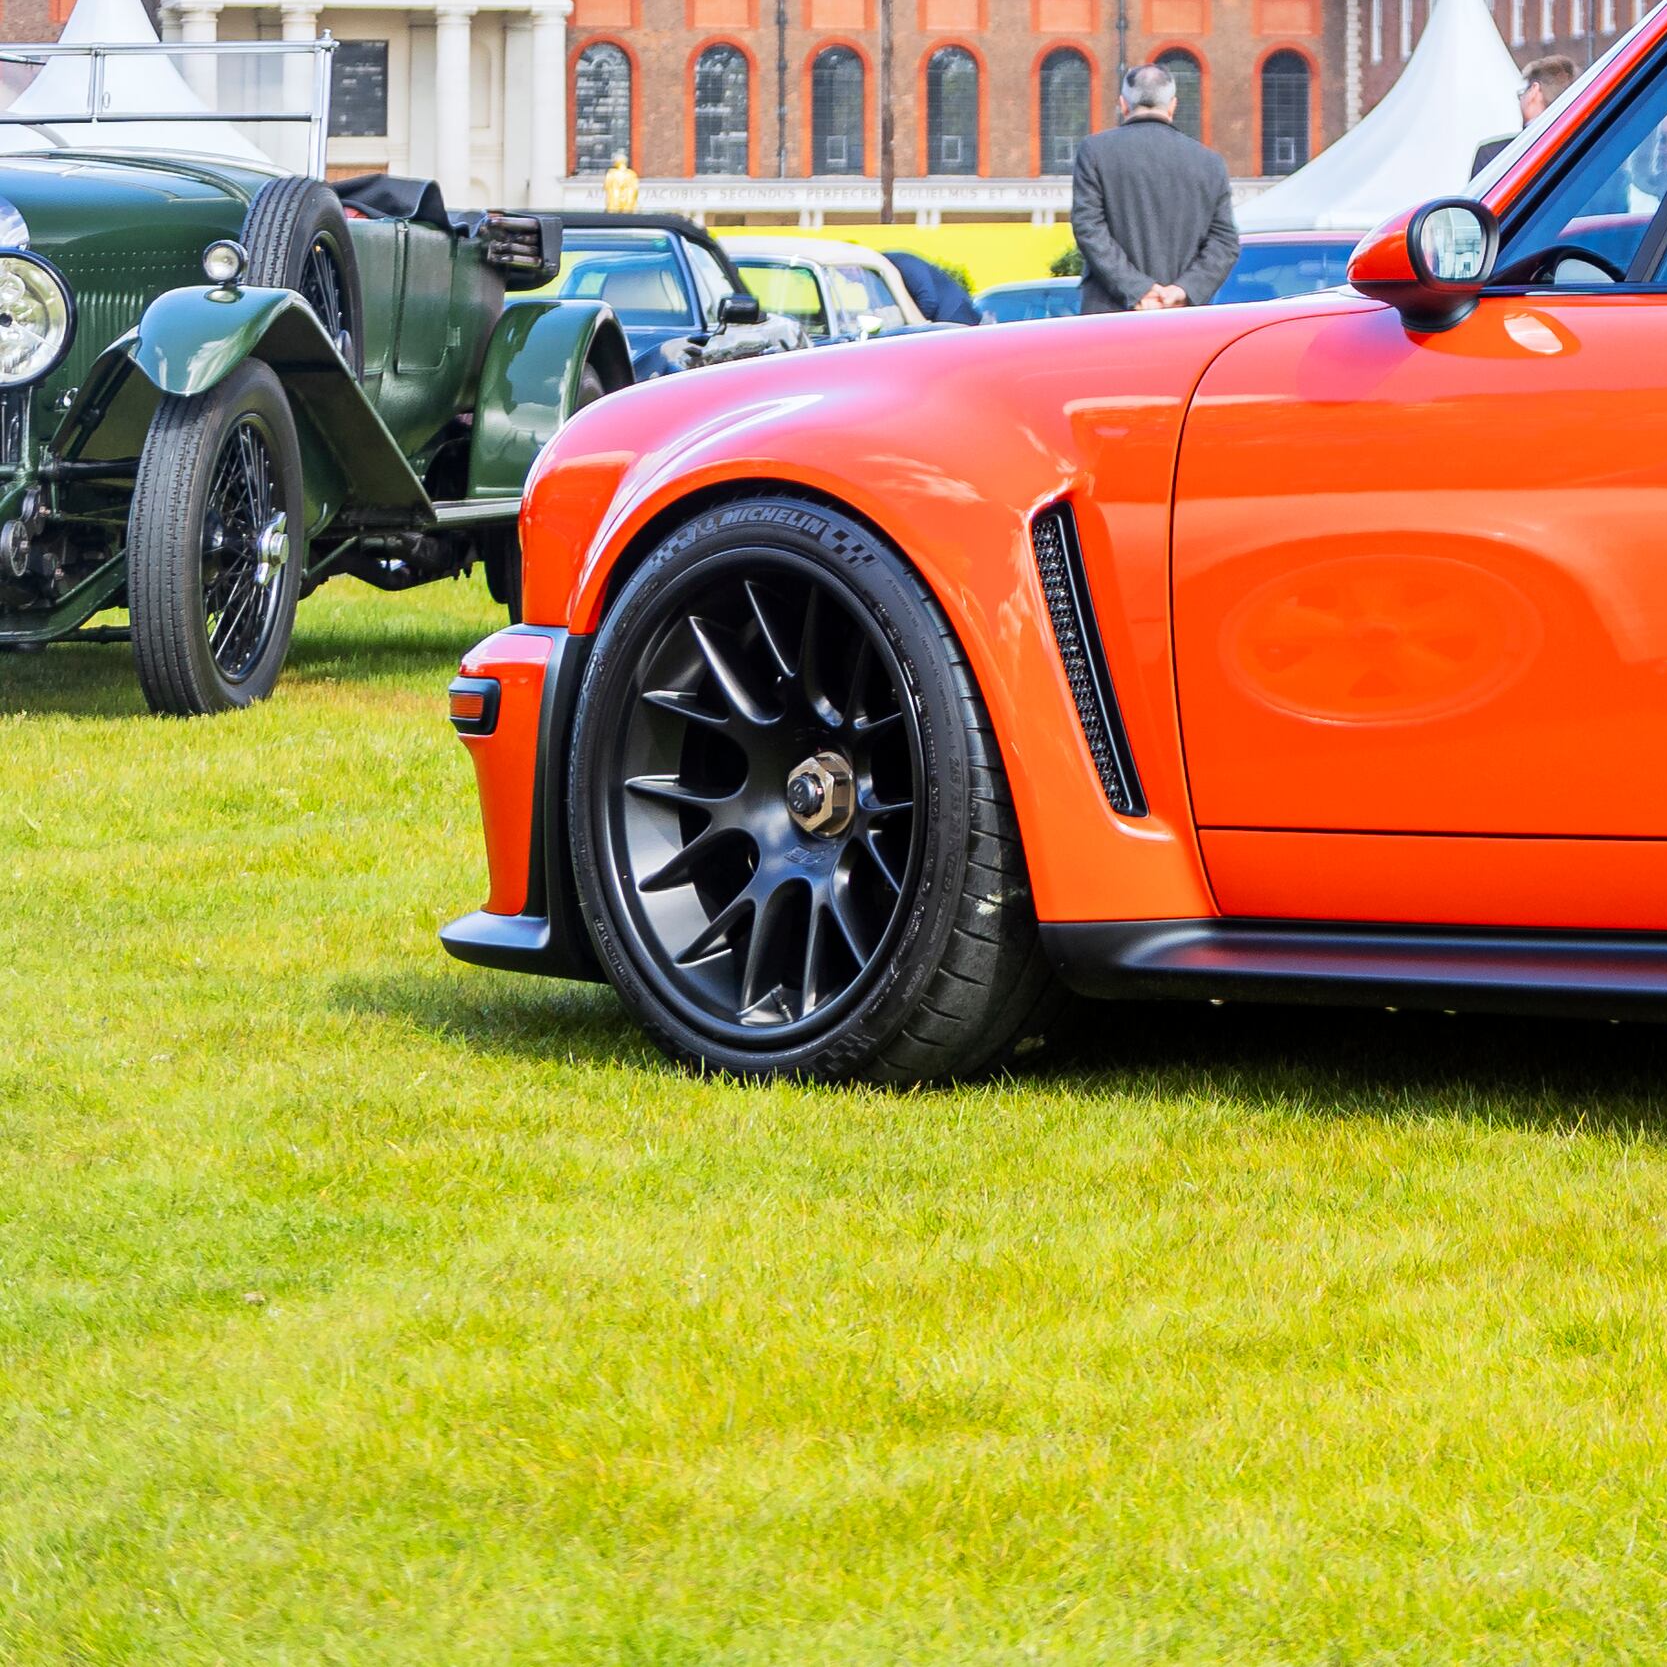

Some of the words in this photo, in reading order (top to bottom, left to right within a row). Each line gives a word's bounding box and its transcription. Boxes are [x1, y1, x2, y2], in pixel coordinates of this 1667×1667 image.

[644, 189, 708, 200] JACOBUS
[719, 189, 795, 200] SECUNDUS
[806, 188, 881, 199] PERFECER
[898, 188, 978, 199] GULIELMUS
[988, 188, 1006, 199] ET
[1018, 188, 1065, 199] MARIA
[719, 506, 828, 535] MICHELIN
